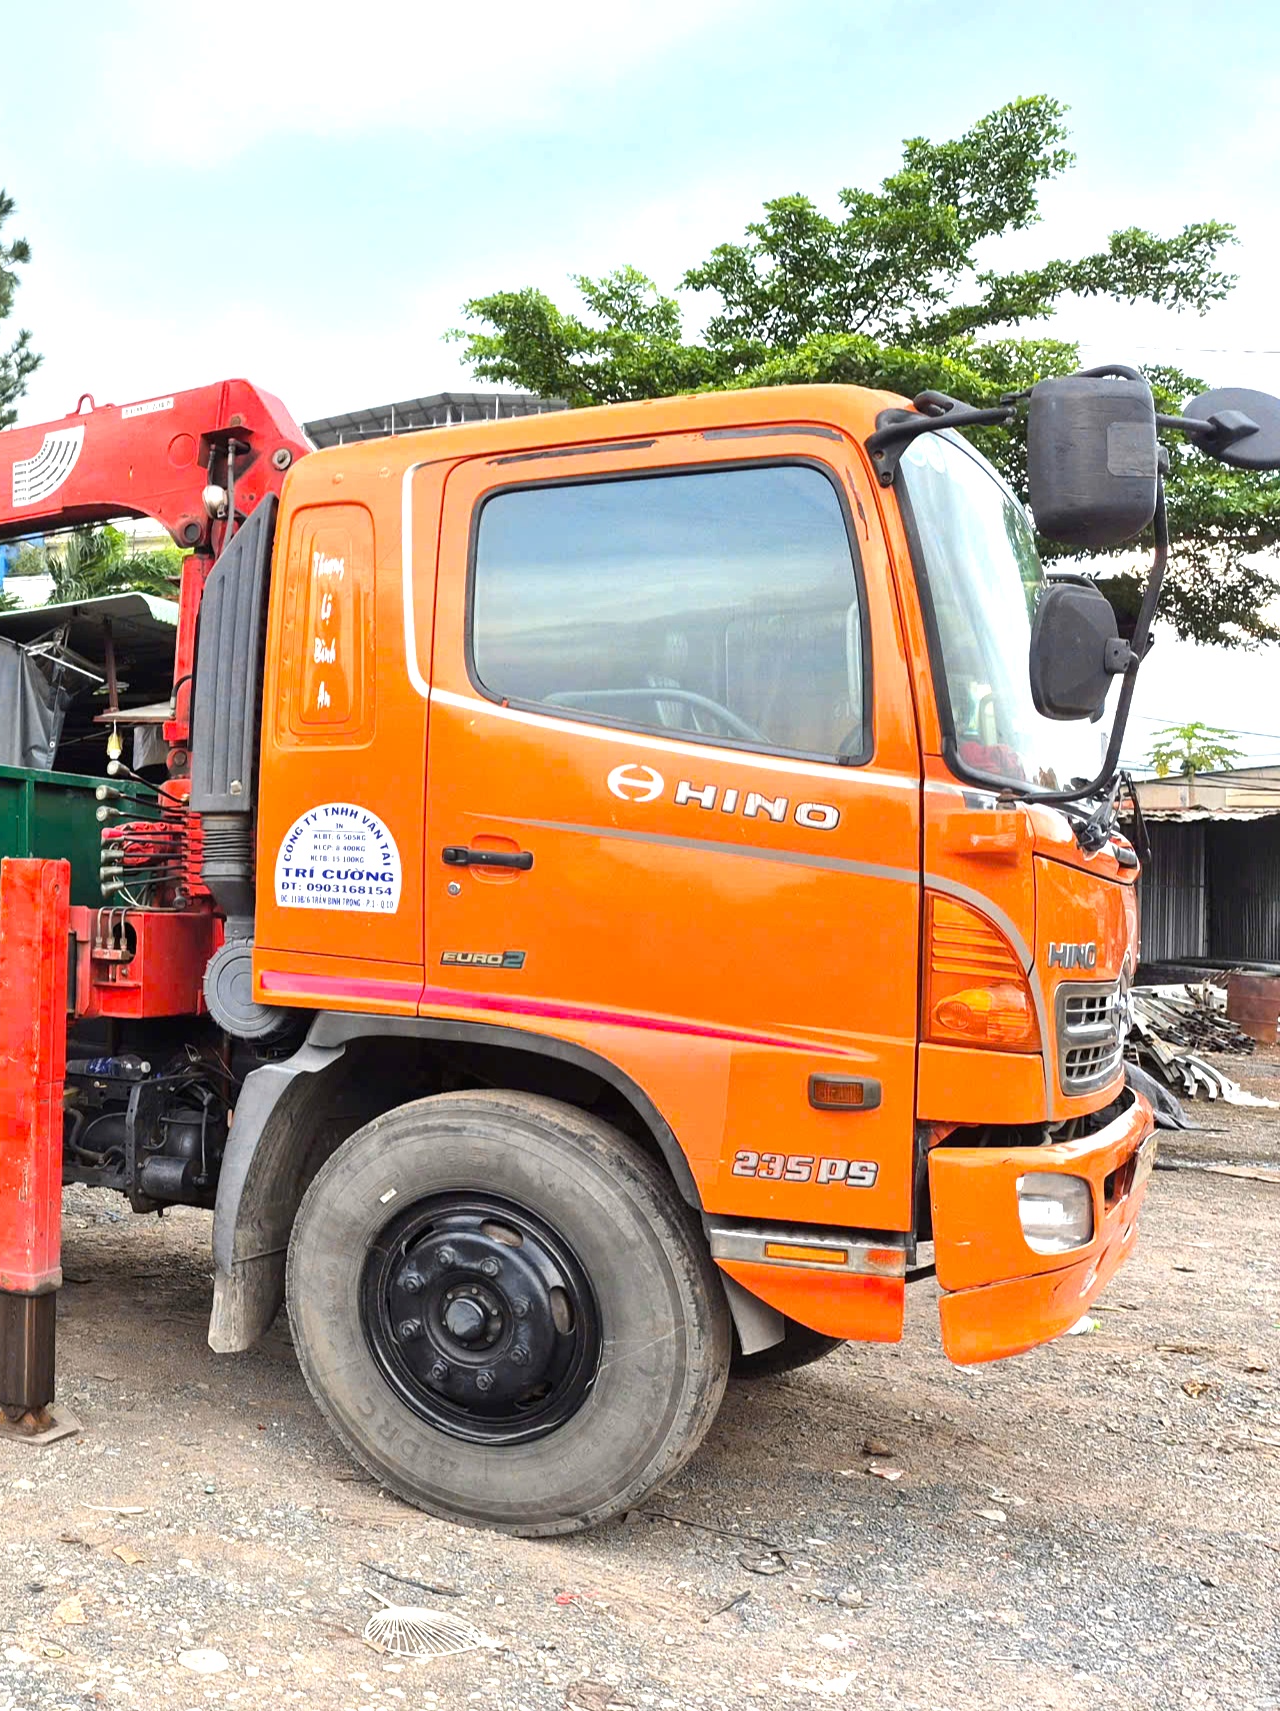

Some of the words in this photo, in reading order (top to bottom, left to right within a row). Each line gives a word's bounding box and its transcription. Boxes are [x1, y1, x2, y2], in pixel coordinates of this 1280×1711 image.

[674, 780, 841, 831] HINO
[283, 826, 304, 862] CÔNG
[303, 812, 318, 826] TY
[323, 806, 359, 819] TNHH
[281, 866, 315, 878] TRÍ
[321, 867, 394, 882] CƯỜNG
[281, 881, 302, 891] ĐT:
[306, 883, 392, 896] 0903168154
[1047, 942, 1097, 970] HINO
[732, 1150, 815, 1183] 235
